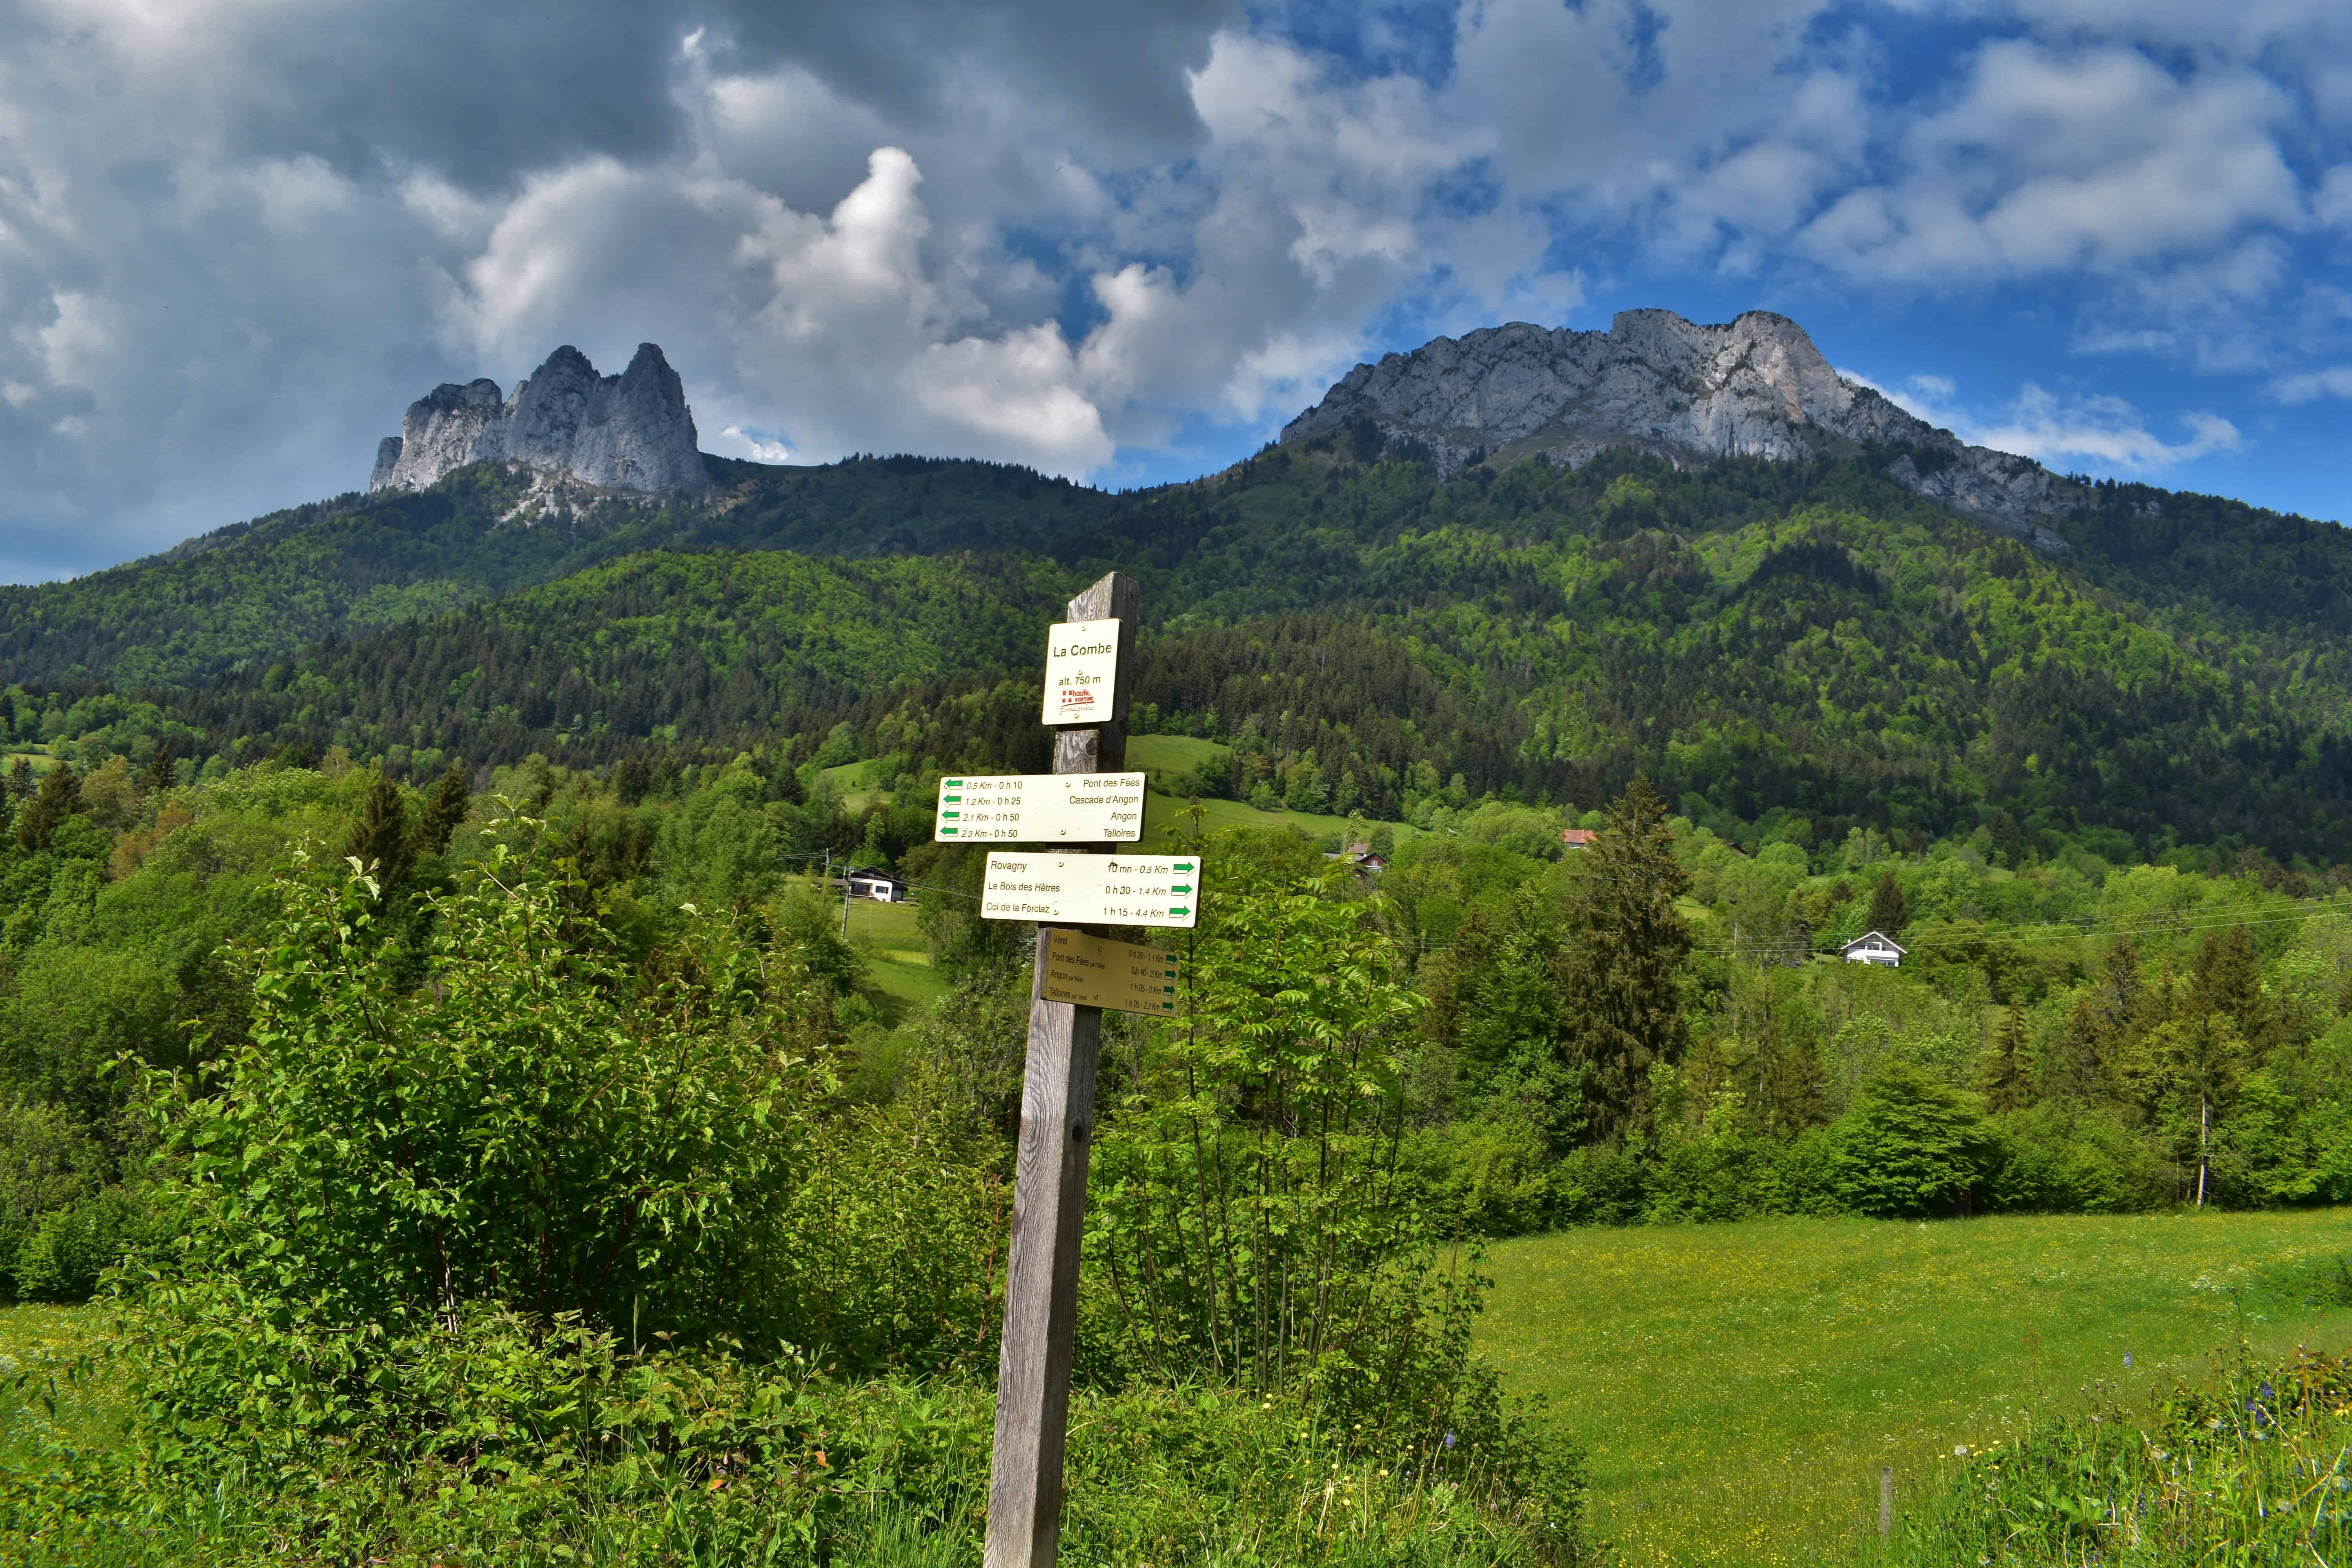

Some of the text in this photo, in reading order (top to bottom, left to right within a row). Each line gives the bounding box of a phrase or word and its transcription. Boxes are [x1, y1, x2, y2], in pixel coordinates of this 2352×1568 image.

[1053, 643, 1112, 657] La Combe
[1059, 677, 1072, 686] alt.
[1075, 676, 1090, 685] 750
[1120, 778, 1140, 786] Fées
[1106, 795, 1138, 805] d'Angon
[1111, 812, 1137, 822] Angon
[1103, 829, 1135, 837] Talloires
[991, 860, 1027, 872] Rovagny
[1109, 864, 1118, 873] 10
[1154, 866, 1168, 874] Km
[989, 882, 1060, 892] Le Bois des Hêtres
[1105, 886, 1111, 894] 0
[1113, 886, 1118, 894] h
[1120, 886, 1131, 895] 30
[1152, 887, 1166, 895] Km
[986, 902, 1050, 913] Col de la Forclaz
[1104, 907, 1107, 915] 1
[1110, 907, 1115, 916] h
[1118, 908, 1128, 916] 15
[1150, 909, 1164, 918] Km
[1054, 934, 1067, 945] Vérel
[1052, 951, 1064, 962] Pont
[1065, 954, 1075, 964] des
[1076, 956, 1089, 966] Fées
[1138, 951, 1143, 960] 20
[1156, 954, 1164, 963] Km
[1051, 969, 1067, 981] Angon
[1154, 970, 1163, 978] Km
[1049, 987, 1071, 998] Talloires
[1131, 982, 1133, 991] 1
[1134, 983, 1138, 991] h
[1139, 984, 1145, 992] 05
[1153, 986, 1161, 994] Km
[1125, 998, 1127, 1007] 1
[1129, 999, 1132, 1007] h
[1134, 1000, 1140, 1008] 05
[1152, 1002, 1160, 1010] Km
